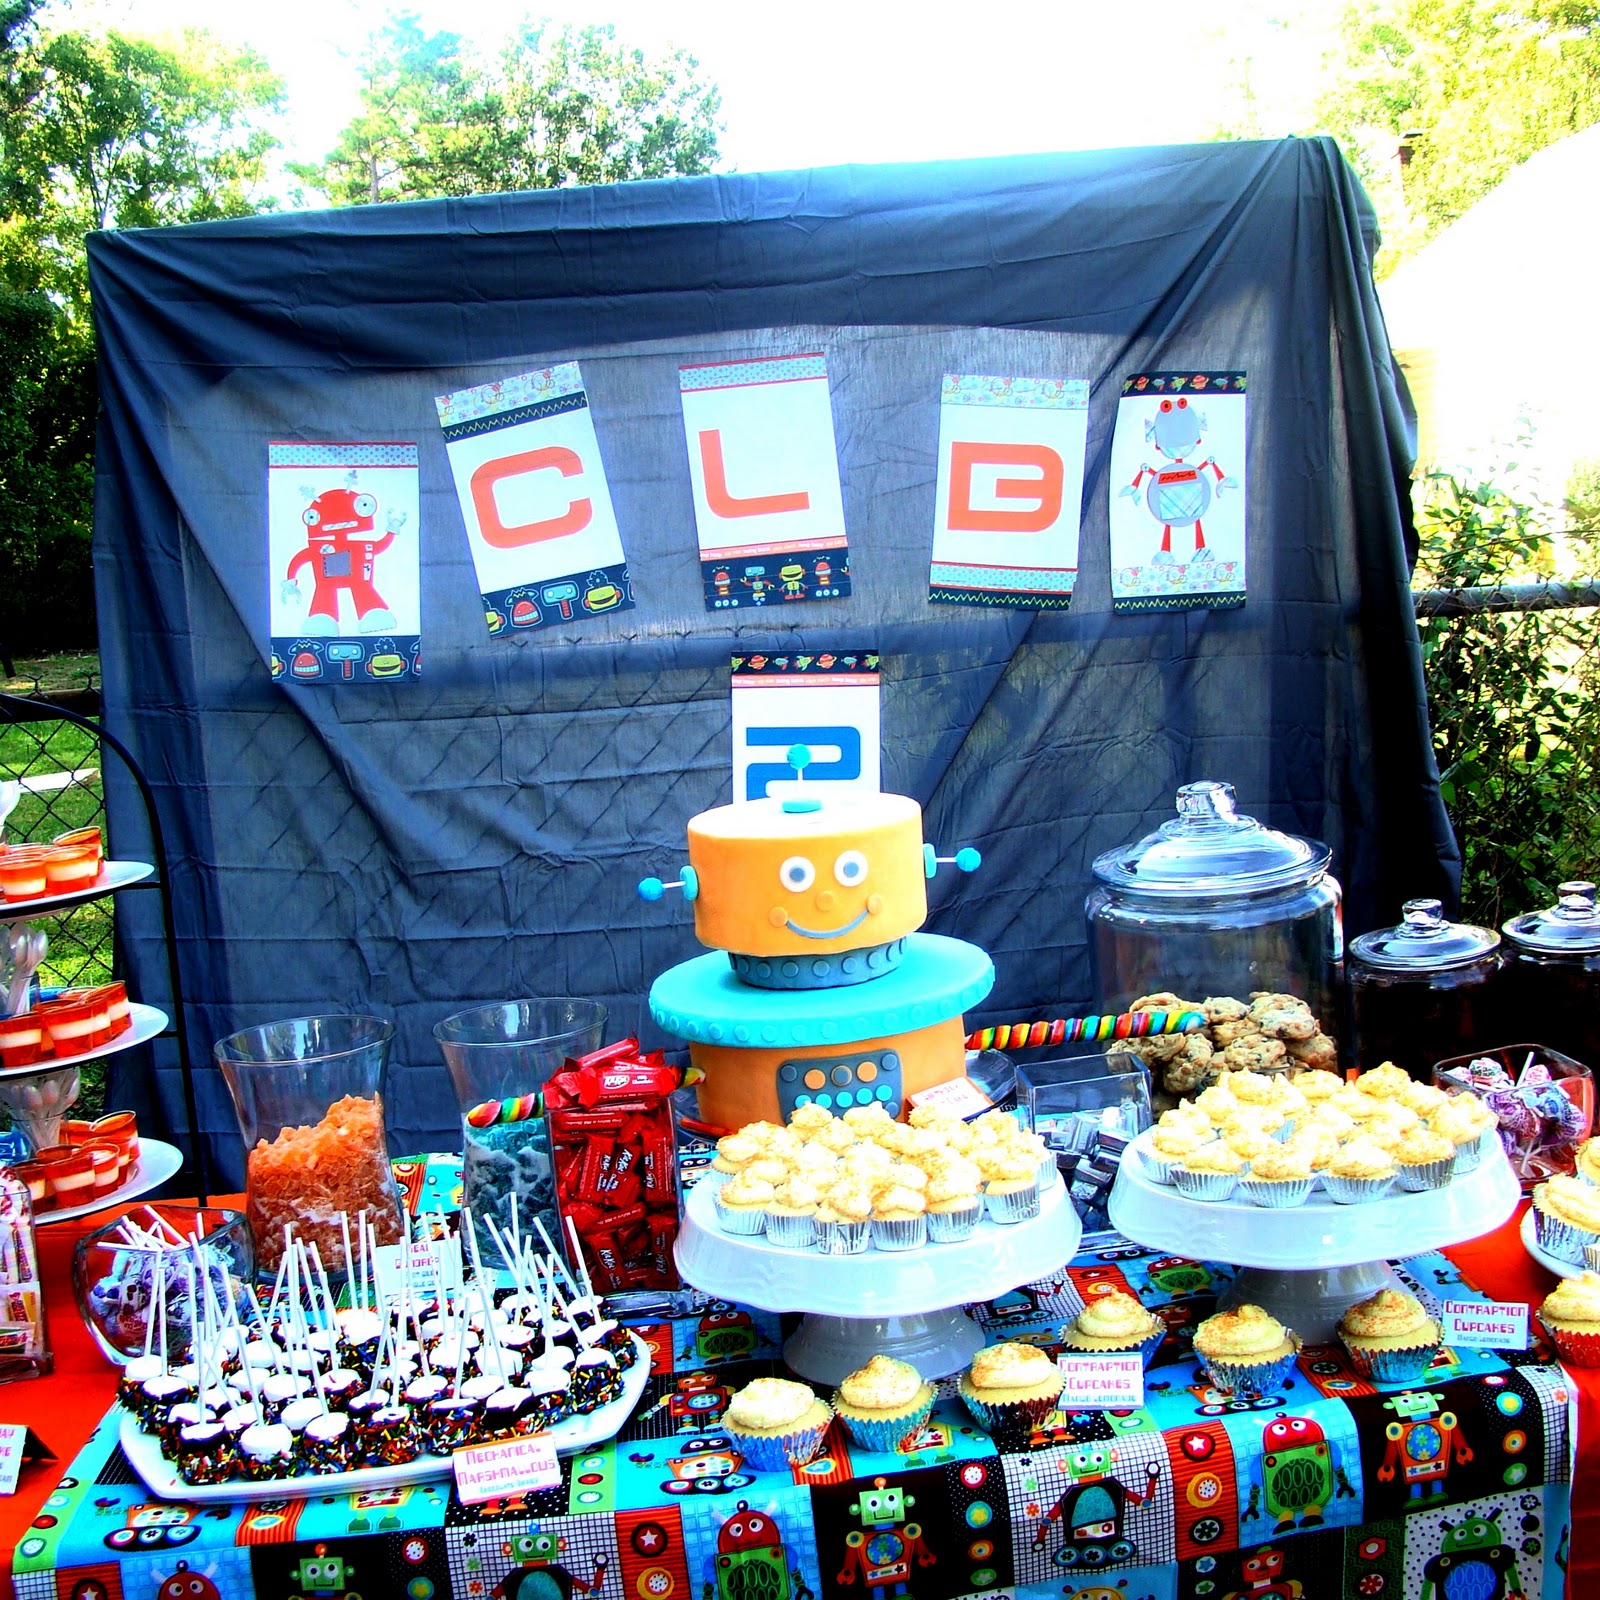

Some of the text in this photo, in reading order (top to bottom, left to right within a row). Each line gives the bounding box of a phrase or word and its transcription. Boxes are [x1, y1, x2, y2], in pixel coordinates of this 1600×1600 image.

[470, 429, 1065, 549] C L B
